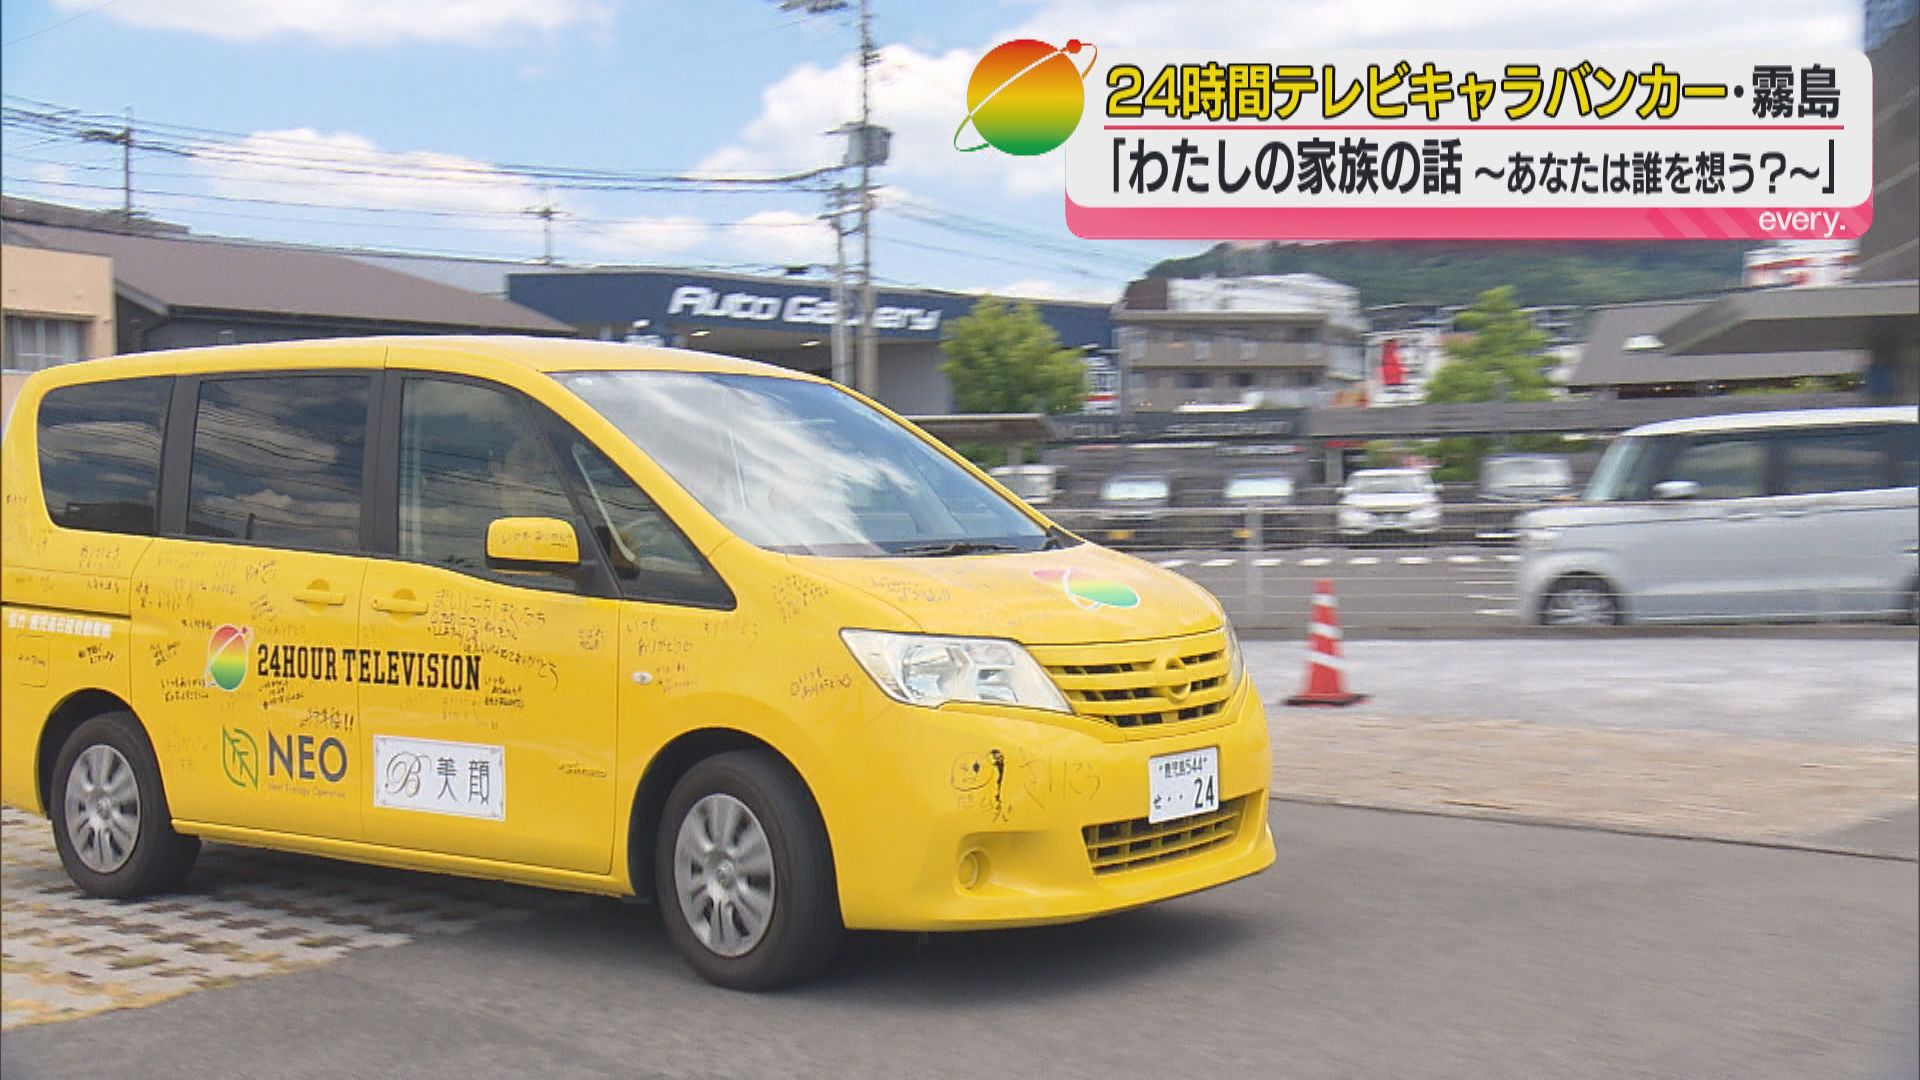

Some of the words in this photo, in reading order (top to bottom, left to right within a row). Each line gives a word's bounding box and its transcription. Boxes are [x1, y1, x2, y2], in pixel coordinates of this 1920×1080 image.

[667, 285, 782, 320] Auto
[782, 296, 943, 331] Gaery
[257, 644, 338, 681] 24HOUR
[342, 649, 482, 690] TELEVISION
[268, 729, 348, 782] NEO
[436, 757, 491, 805] 美顔
[1194, 774, 1214, 809] 24
